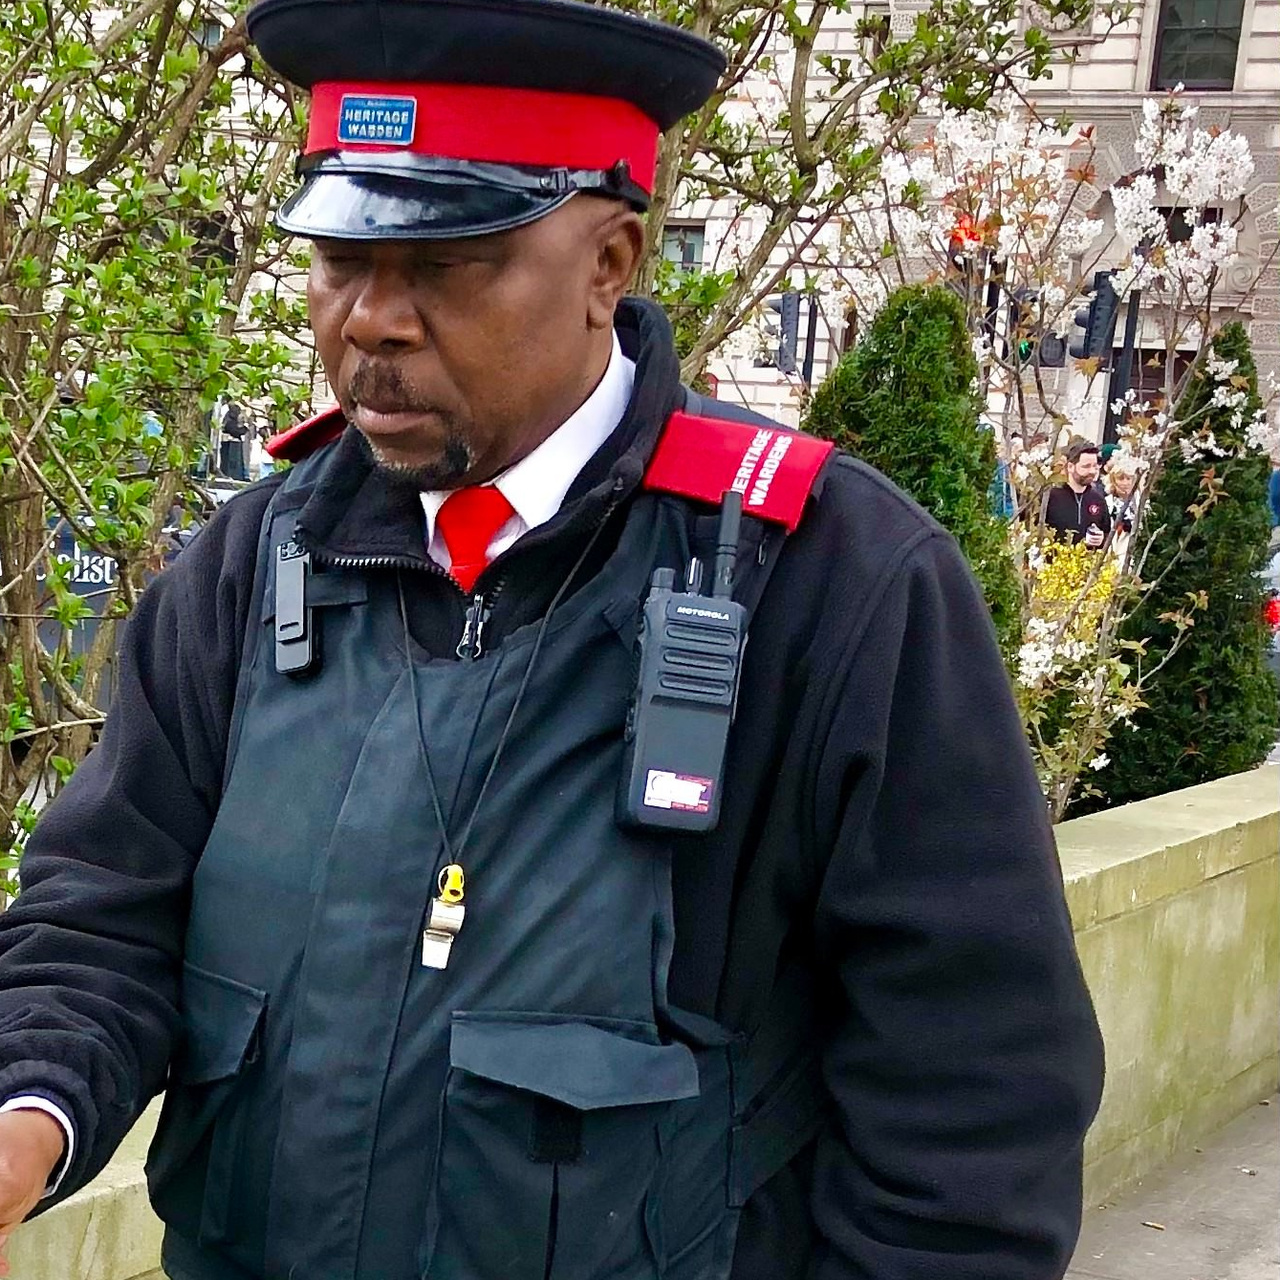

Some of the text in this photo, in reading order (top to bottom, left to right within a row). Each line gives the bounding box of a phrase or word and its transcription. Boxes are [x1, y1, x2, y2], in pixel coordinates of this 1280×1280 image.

[345, 109, 409, 124] HERITAGE
[348, 124, 403, 138] WARDEN
[748, 435, 793, 505] WARDENS
[676, 606, 729, 621] MOTOROLA
